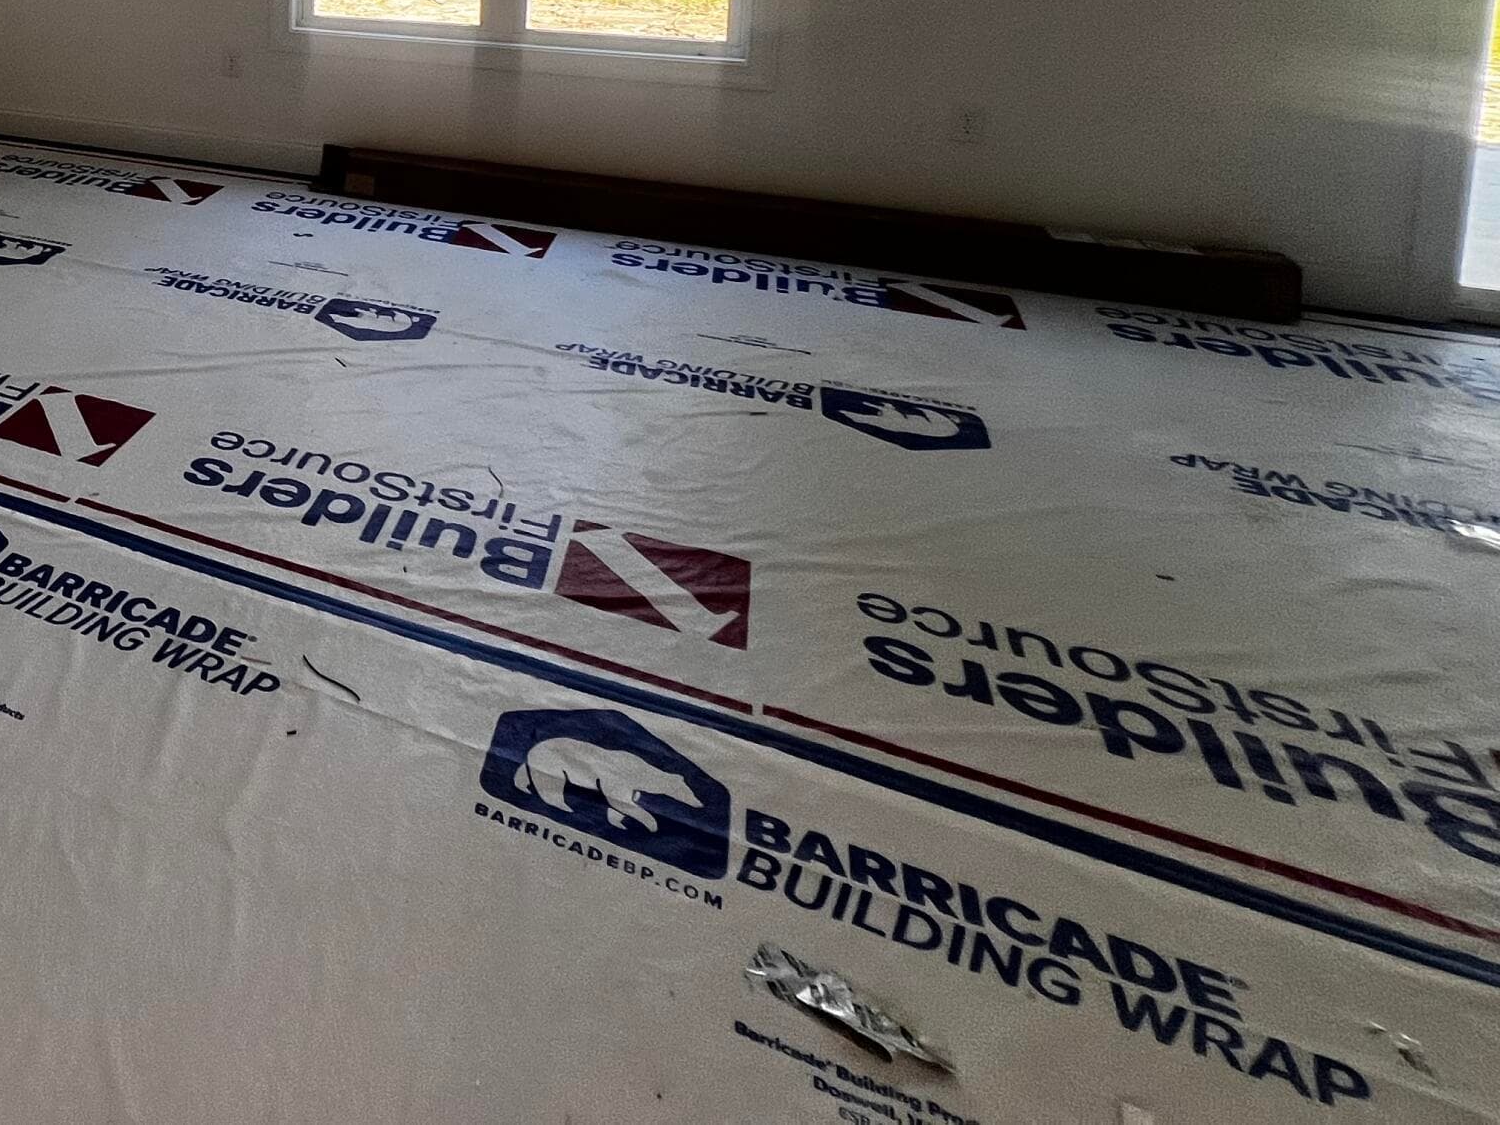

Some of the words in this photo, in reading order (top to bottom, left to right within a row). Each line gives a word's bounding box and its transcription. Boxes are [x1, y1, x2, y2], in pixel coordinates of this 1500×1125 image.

[250, 200, 458, 244] Builders
[264, 191, 471, 231] FirstSource
[611, 252, 890, 309] Builders
[612, 240, 897, 288] FirstSource
[155, 275, 316, 315] BARRICADE
[554, 341, 644, 364] WRAP
[656, 358, 815, 397] BUILDING
[589, 356, 813, 412] BARRICADE
[208, 430, 562, 545] FirstSource
[1169, 453, 1309, 491] WRAP
[182, 456, 556, 592] Builders
[150, 633, 281, 698] WRAP
[857, 592, 1499, 790] FirstSource
[862, 635, 1500, 867] Builders
[473, 801, 725, 912] BARRICADEBP.COM
[745, 808, 1246, 1021] BARRICADE
[736, 847, 1082, 1006] BUILDING
[1108, 979, 1372, 1107] WRAP
[835, 1064, 923, 1113] Building
